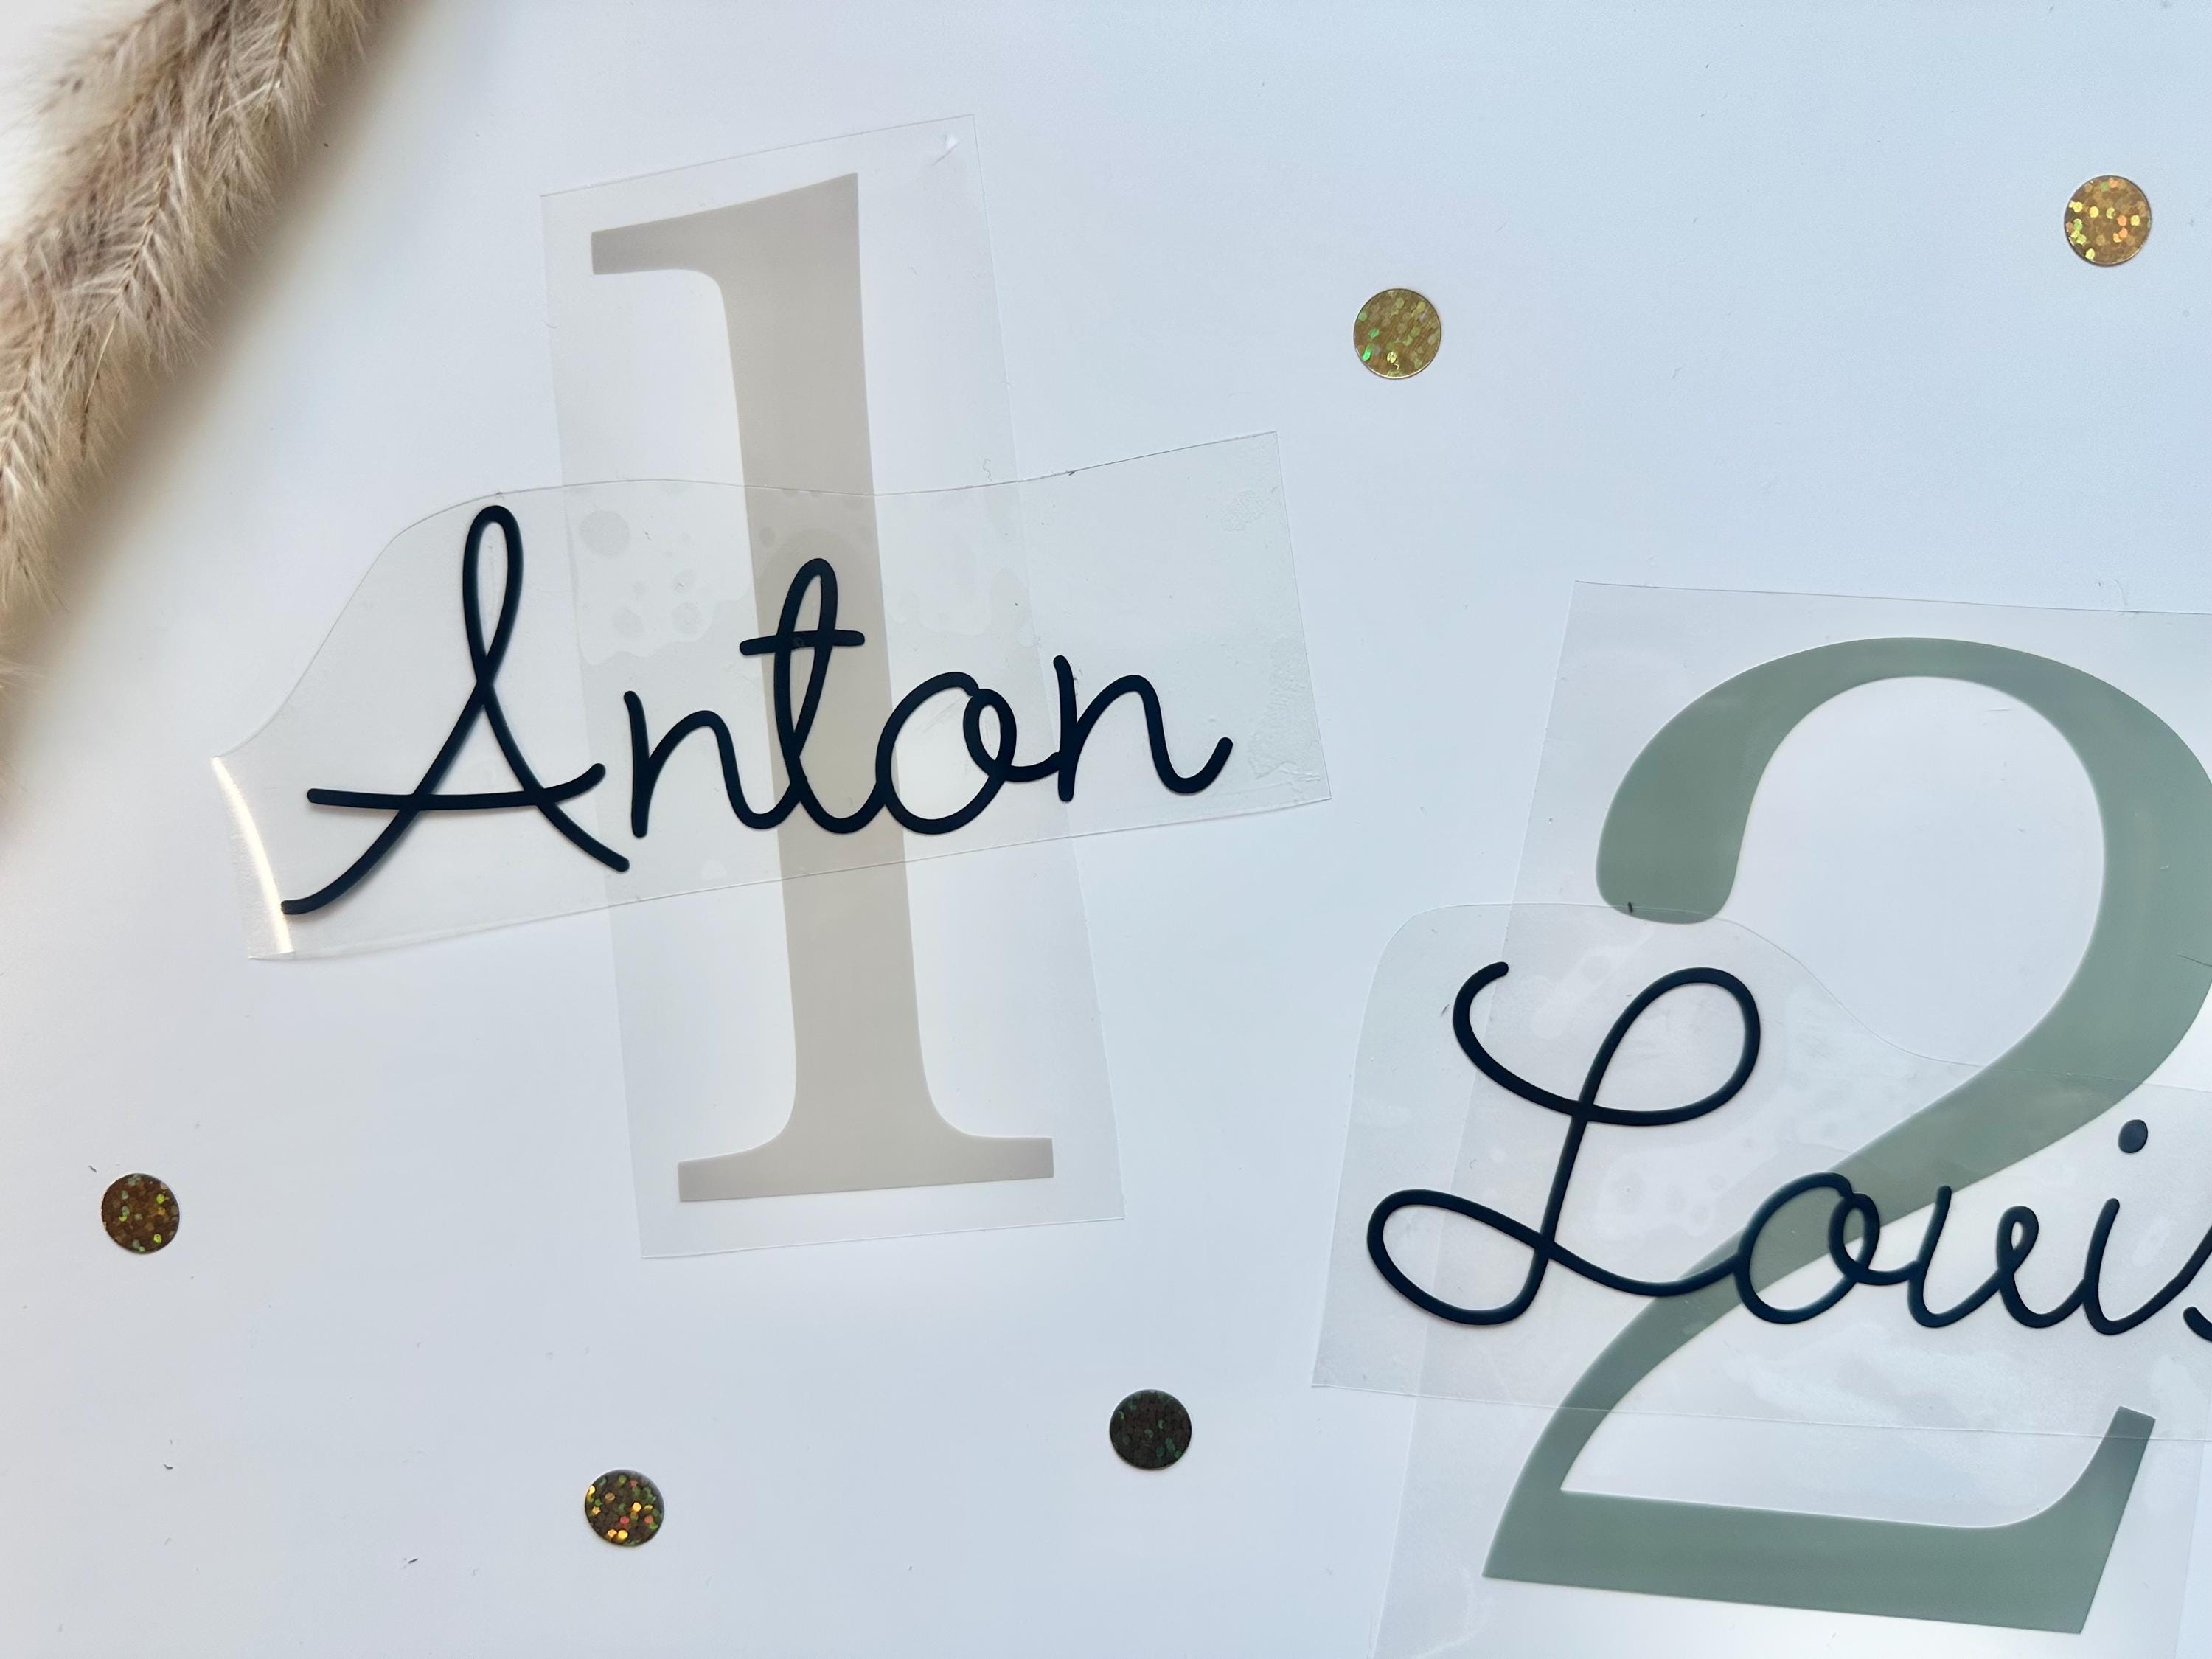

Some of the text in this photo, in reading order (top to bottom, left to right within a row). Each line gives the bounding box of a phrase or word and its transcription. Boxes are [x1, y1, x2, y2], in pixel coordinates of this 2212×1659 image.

[282, 504, 1234, 916] Anton
[592, 173, 1054, 1203] 1
[1483, 636, 2212, 1635] 2
